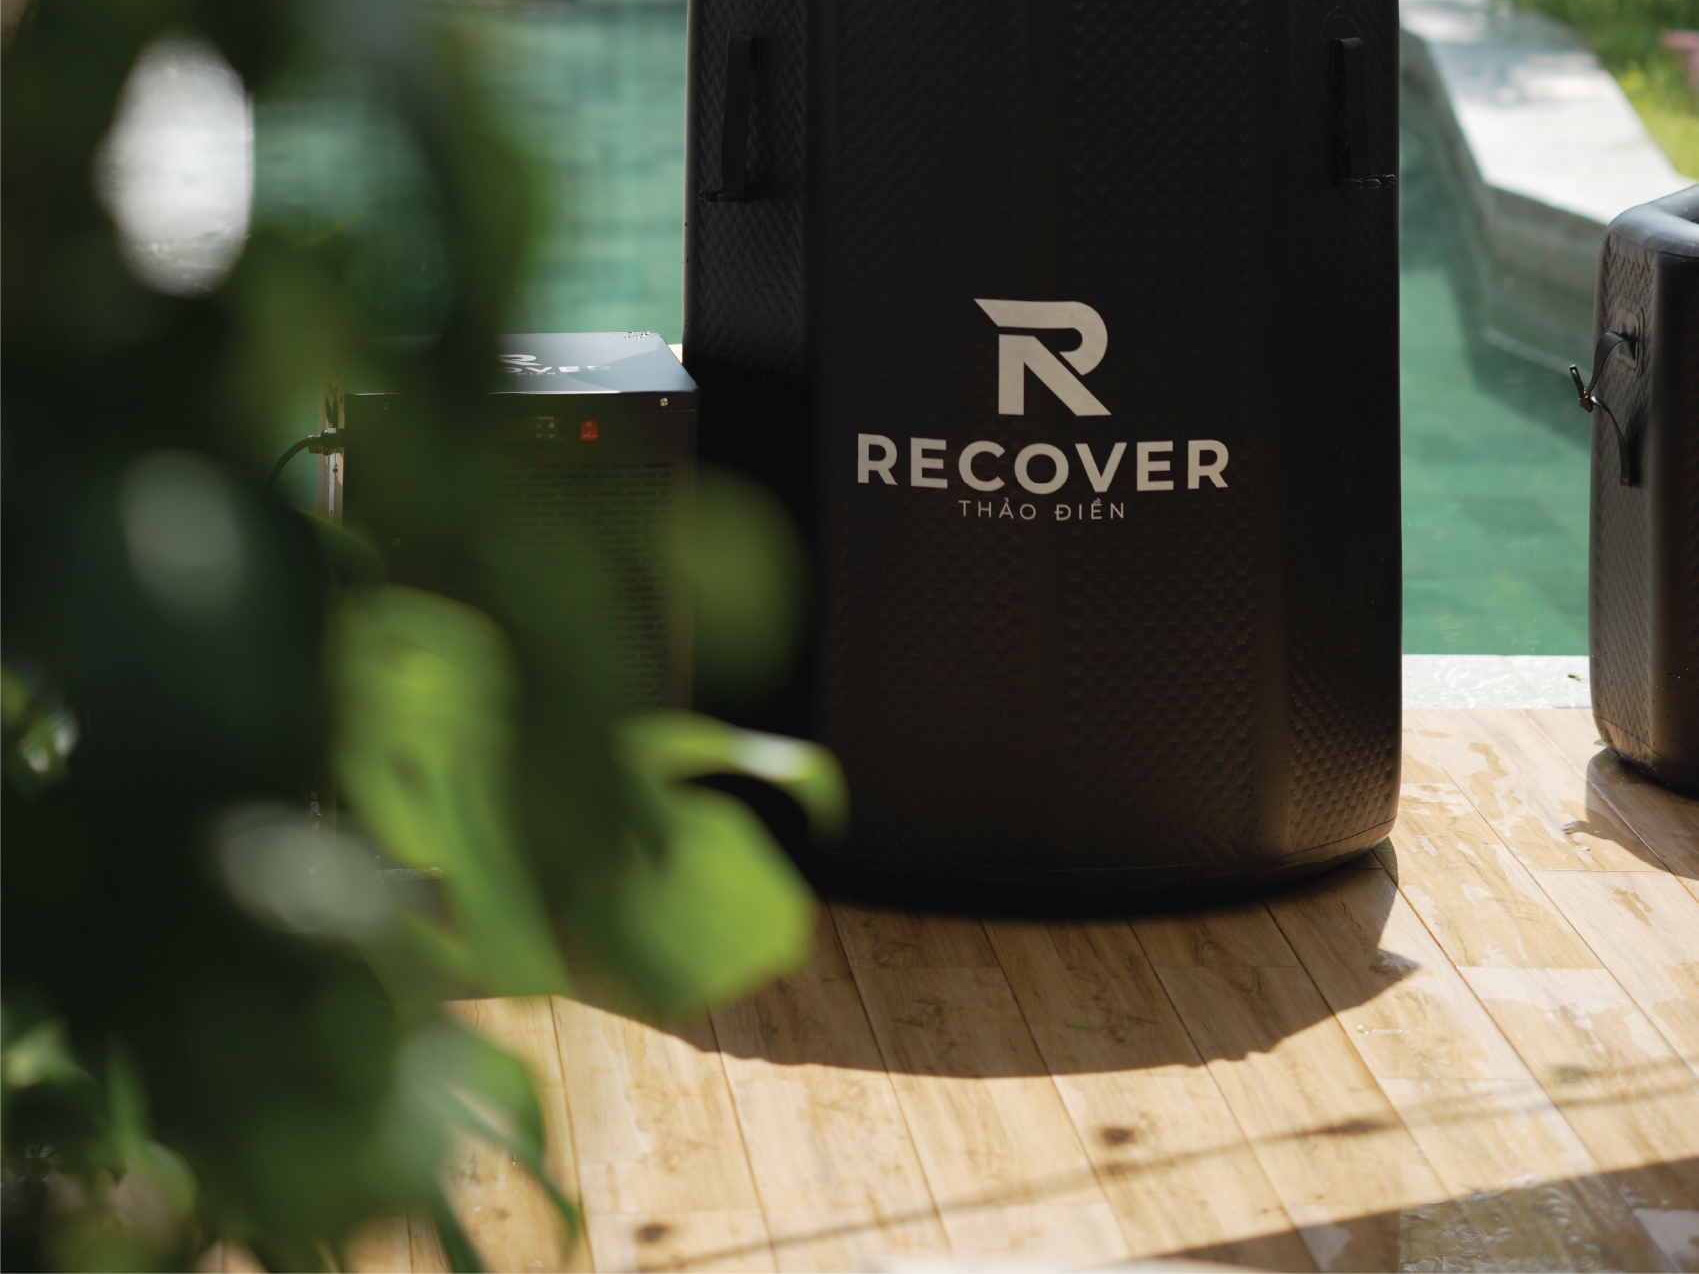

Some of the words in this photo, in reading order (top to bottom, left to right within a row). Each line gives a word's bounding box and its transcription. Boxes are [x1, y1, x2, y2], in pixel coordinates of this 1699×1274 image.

[973, 298, 1112, 417] R
[857, 433, 1230, 495] RECOVER
[958, 497, 1037, 521] THẢO
[1054, 498, 1124, 522] ĐIỀN
